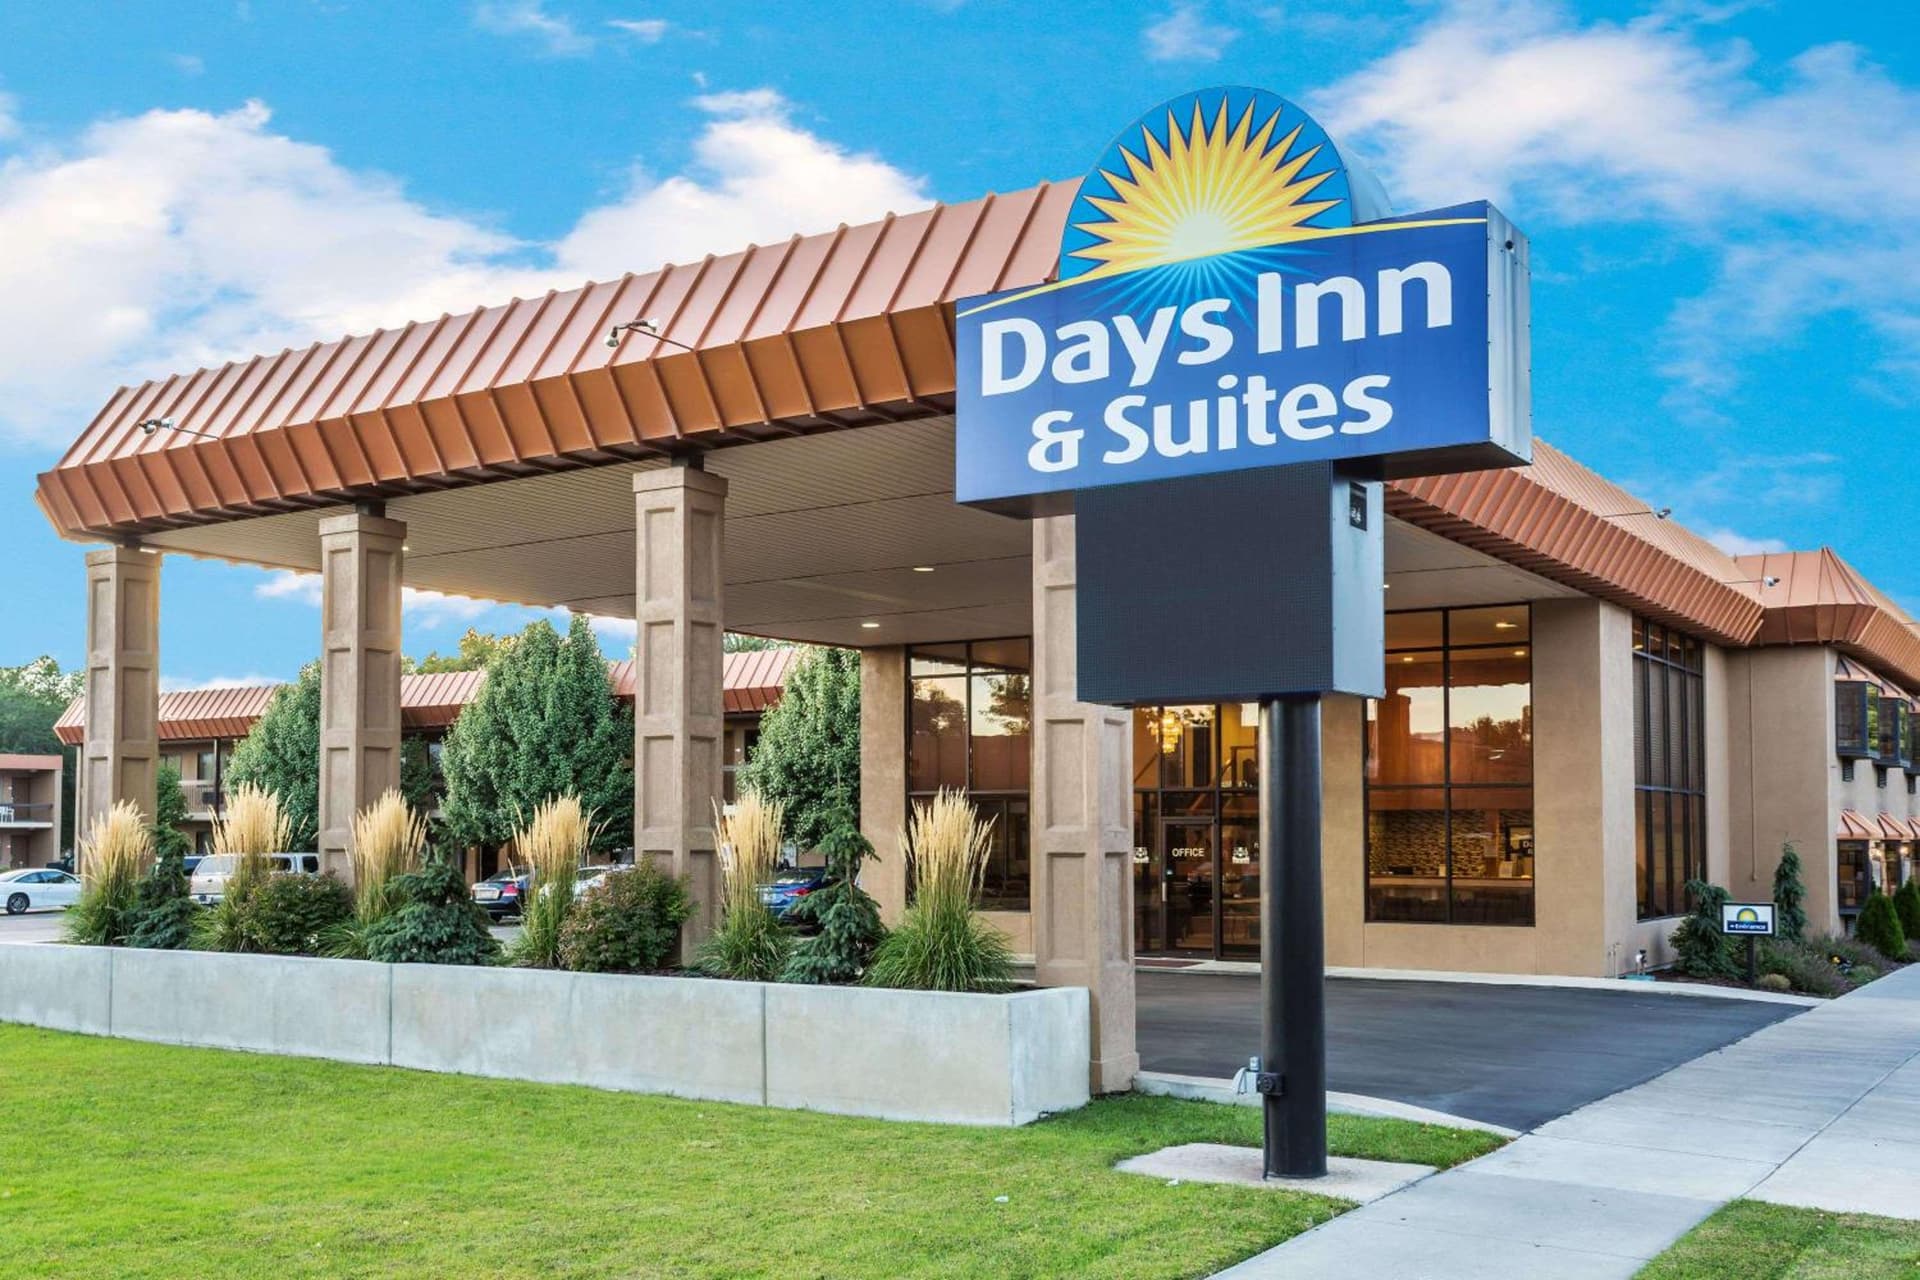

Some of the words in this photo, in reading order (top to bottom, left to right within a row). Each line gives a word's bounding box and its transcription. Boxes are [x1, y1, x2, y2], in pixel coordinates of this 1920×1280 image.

[980, 298, 1234, 398] Days
[1257, 261, 1453, 355] Inn
[1027, 410, 1085, 473] &
[1103, 374, 1394, 464] Suites
[1171, 847, 1205, 858] OFFICE
